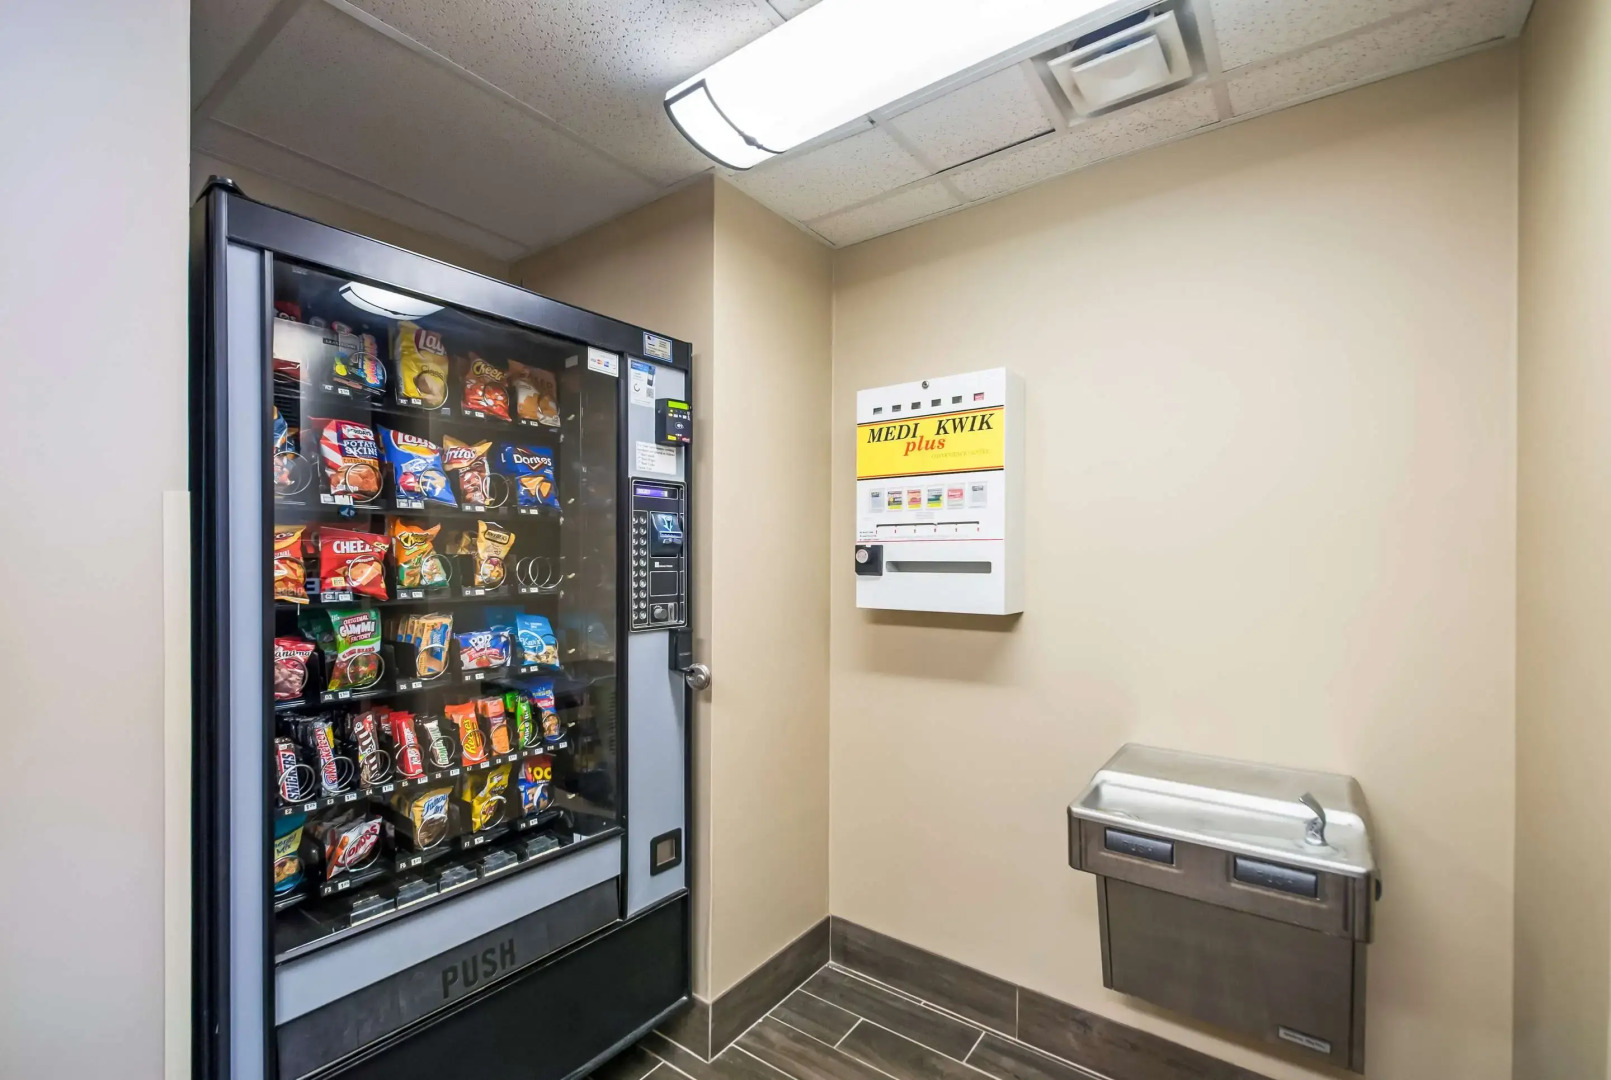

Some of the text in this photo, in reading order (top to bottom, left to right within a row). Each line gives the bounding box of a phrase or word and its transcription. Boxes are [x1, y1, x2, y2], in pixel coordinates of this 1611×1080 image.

[867, 413, 995, 443] MEDI KWIK
[903, 435, 946, 456] plus
[513, 453, 552, 467] Doritos
[339, 620, 376, 637] GUMMI
[343, 614, 369, 625] ORIGINAL
[350, 634, 372, 642] FACTORY
[282, 753, 300, 800] SNICKERS
[441, 937, 516, 999] PUSH
